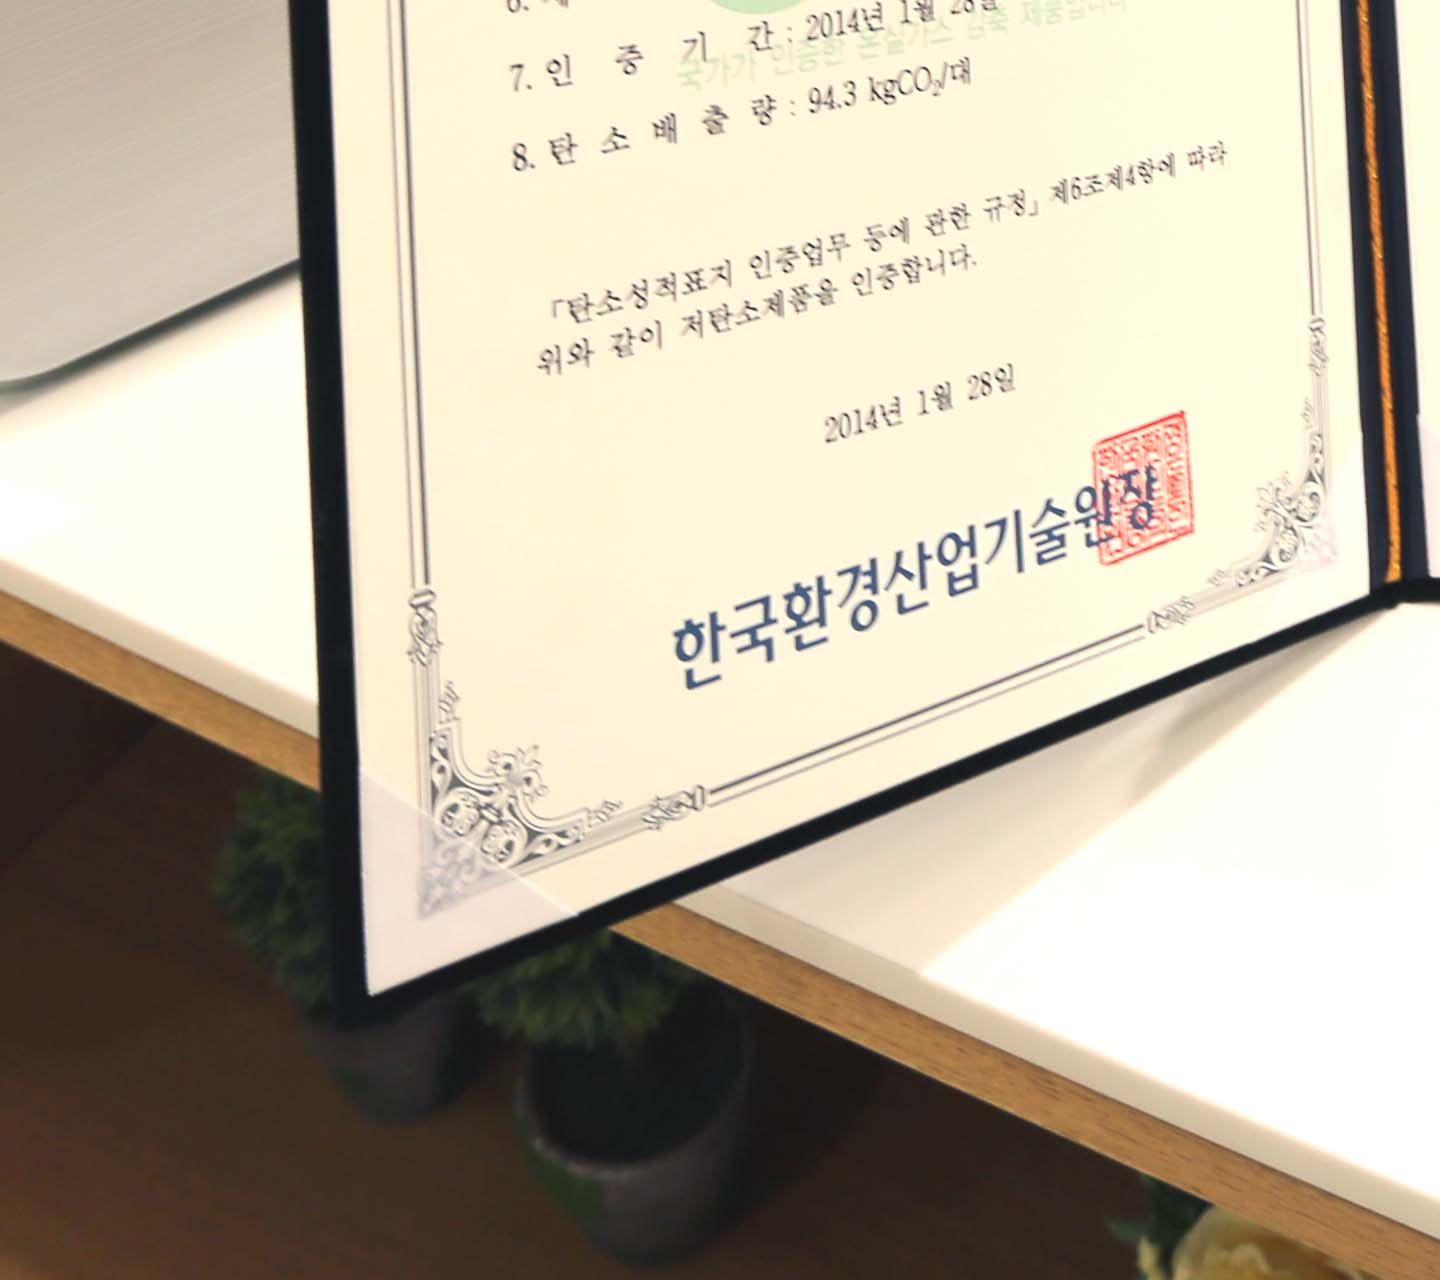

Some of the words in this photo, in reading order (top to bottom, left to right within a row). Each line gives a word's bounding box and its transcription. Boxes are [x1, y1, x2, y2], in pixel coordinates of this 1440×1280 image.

[806, 1, 885, 41] 2014년
[809, 80, 856, 114] 94.3
[749, 233, 851, 280] 인증업무
[925, 203, 971, 237] 관한
[1187, 141, 1227, 170] 따라
[537, 337, 595, 375] 위와
[610, 320, 662, 358] 같이
[682, 268, 838, 338] 저탄소제품을
[851, 243, 977, 297] 인증합니다.
[824, 396, 903, 444] 2014년
[918, 381, 953, 416] 1월
[968, 363, 1015, 401] 28일
[673, 463, 1154, 690] 한국환경산업기술원장
